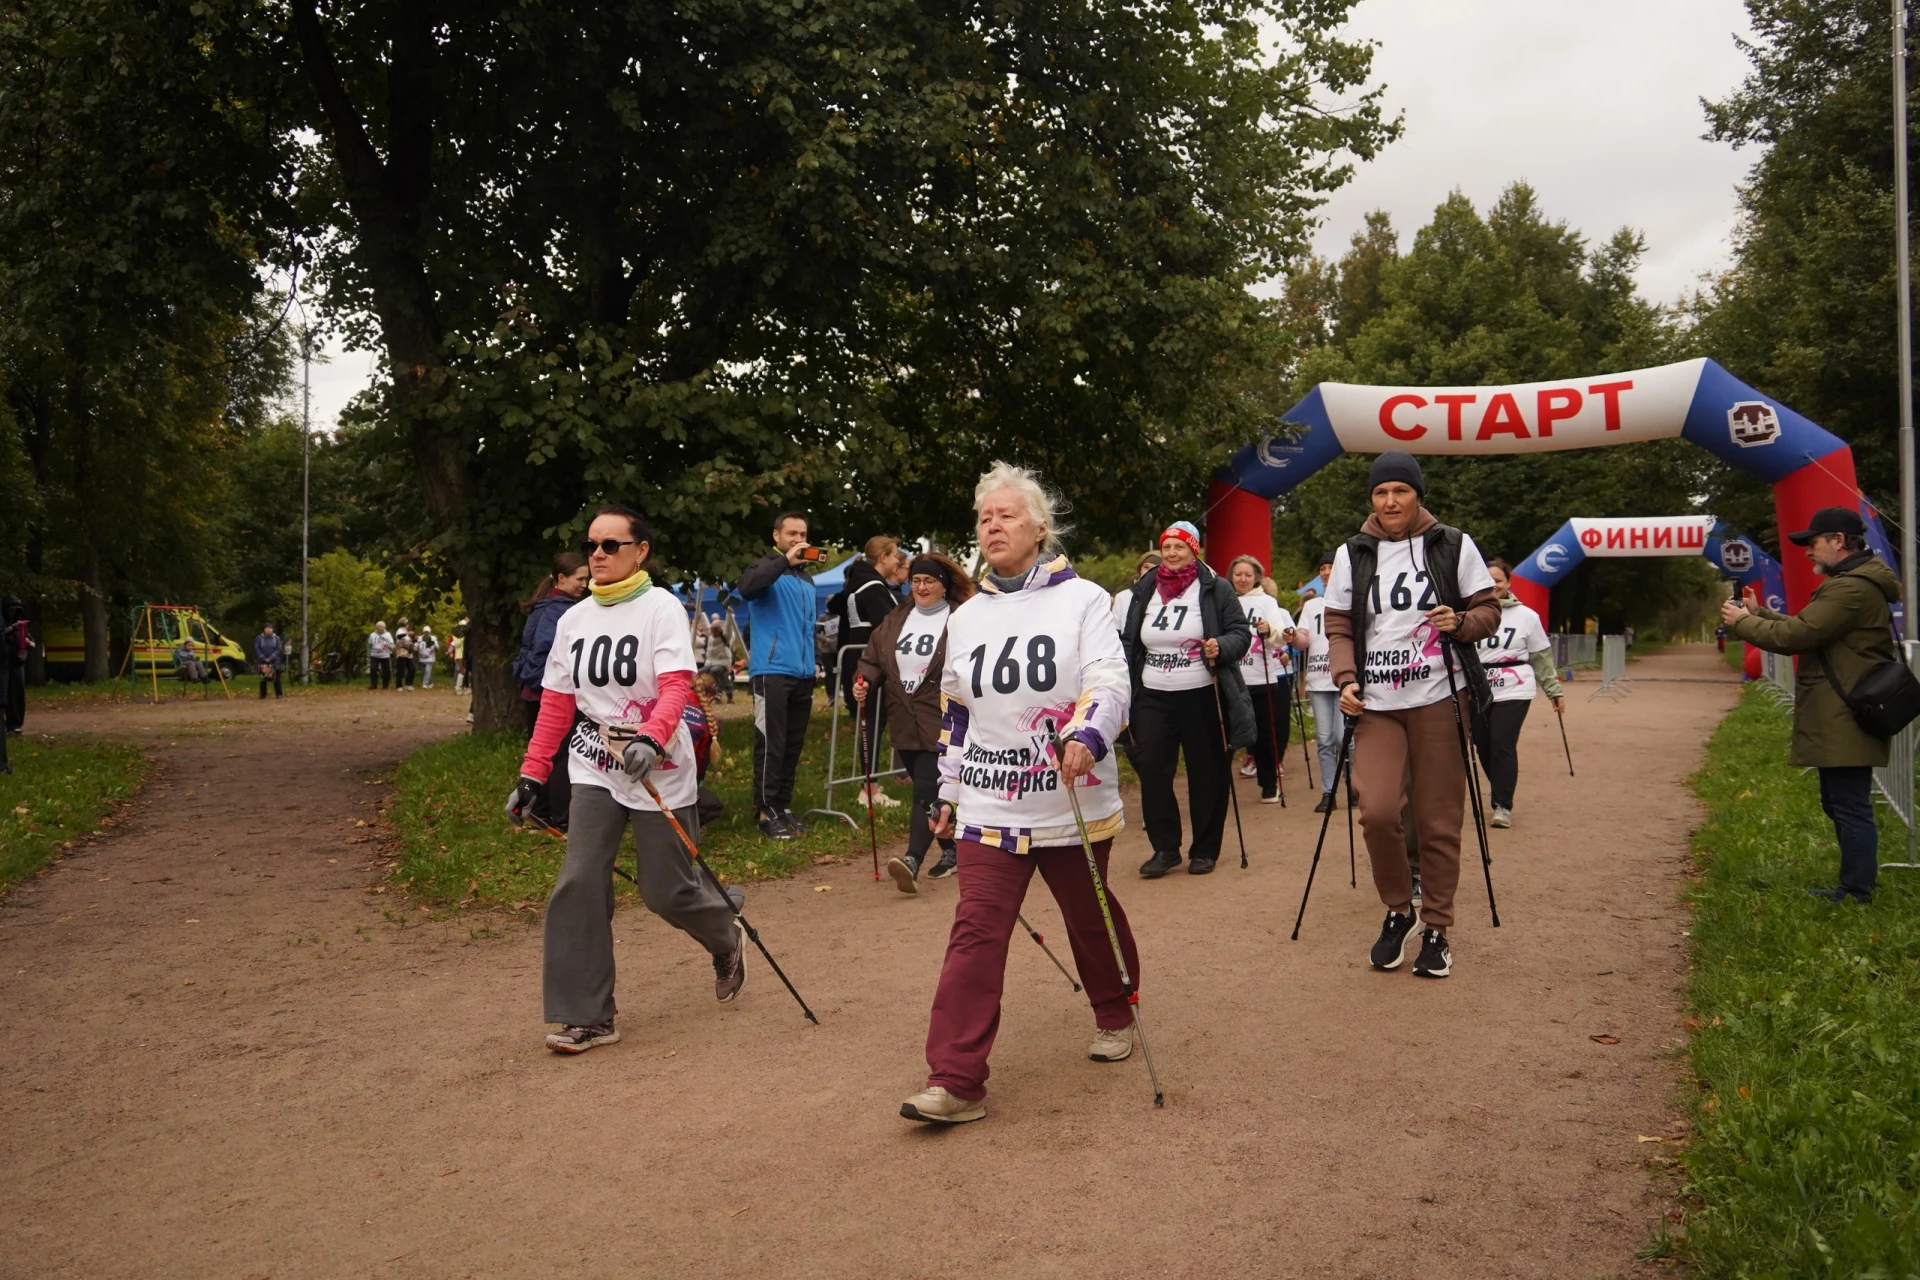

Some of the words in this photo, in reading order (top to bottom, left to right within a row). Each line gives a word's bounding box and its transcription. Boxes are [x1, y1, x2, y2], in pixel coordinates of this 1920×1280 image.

[1378, 380, 1633, 441] СТАРТ
[1580, 526, 1704, 549] ФИНИШ
[1371, 571, 1437, 614] 162
[1151, 605, 1188, 631] 47
[895, 633, 935, 656] 48
[570, 634, 639, 690] 108
[968, 635, 1058, 699] 168
[1366, 649, 1410, 667] нская
[1364, 664, 1431, 688] сьмерка
